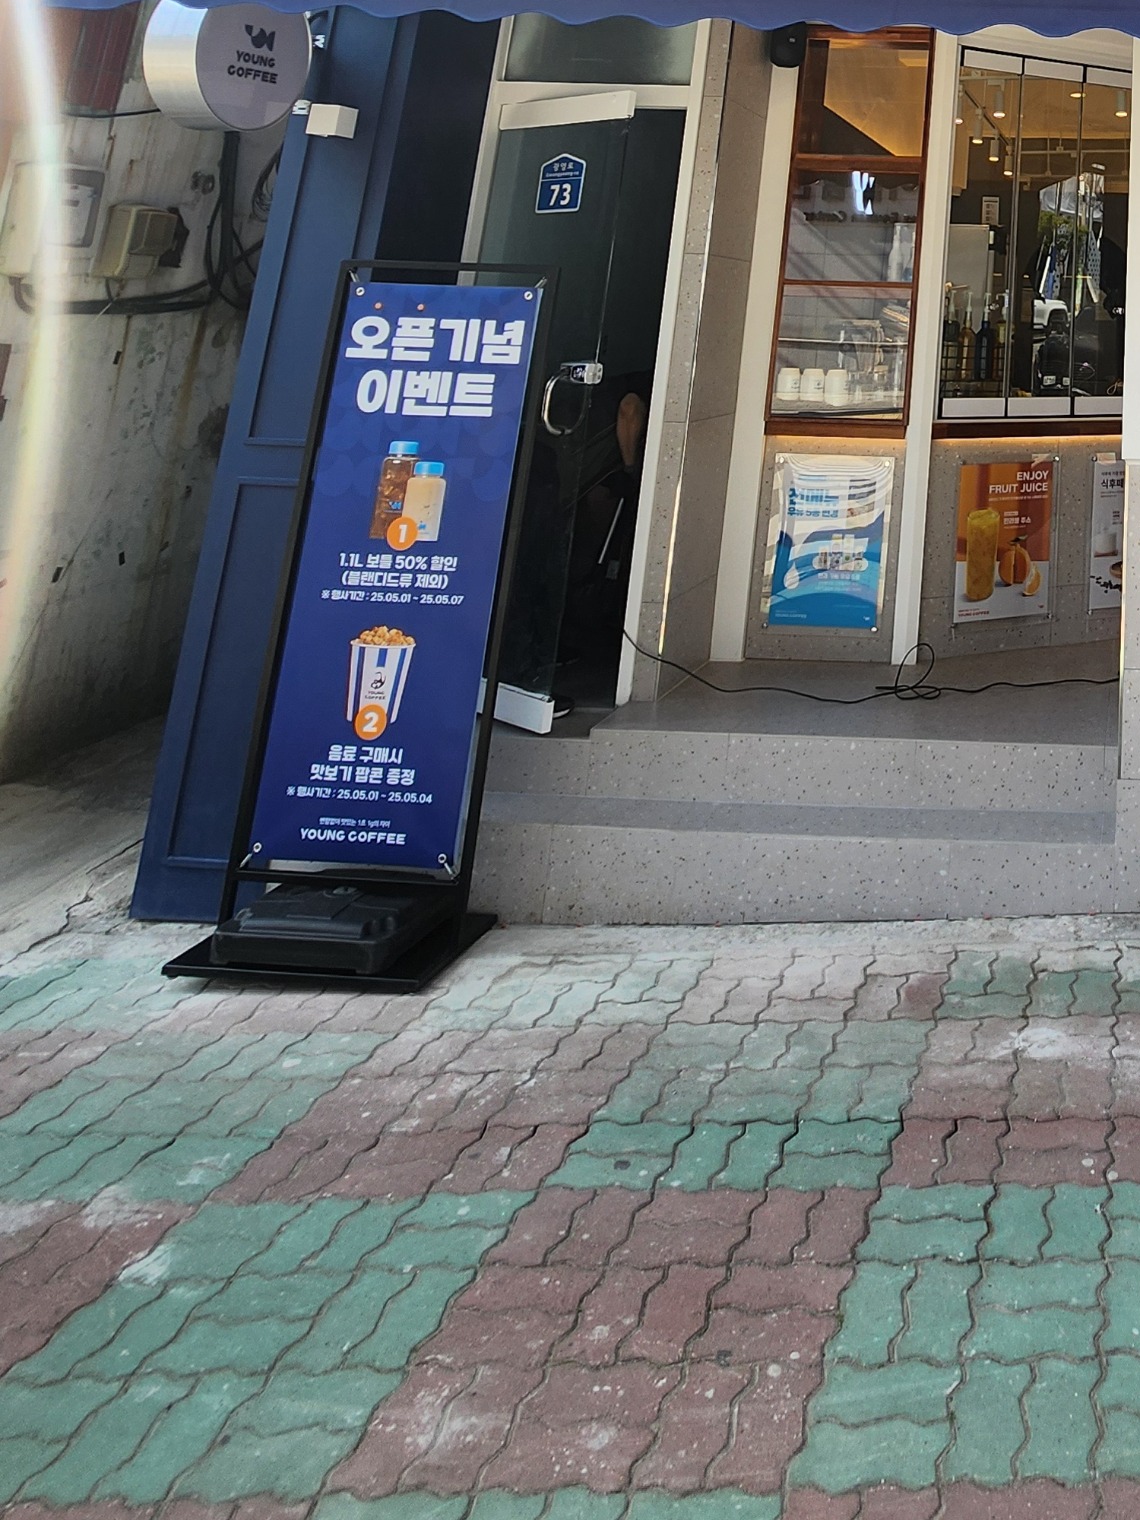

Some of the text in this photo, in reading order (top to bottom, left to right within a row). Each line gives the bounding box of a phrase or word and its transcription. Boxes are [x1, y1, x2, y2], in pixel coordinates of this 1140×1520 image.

[236, 50, 276, 68] YOUNG
[227, 64, 278, 85] COFFEE
[549, 183, 572, 207] 73
[344, 315, 526, 365] 오픈기념
[356, 369, 496, 417] 이벤트
[1016, 470, 1049, 481] ENJOY
[988, 482, 1049, 494] FRUIT JUICE
[398, 524, 408, 543] 1
[339, 553, 458, 572] 1.1L 보틀 50% 할인
[414, 573, 449, 590] 제외)
[370, 592, 411, 603] 25.05.01
[420, 594, 464, 605] 25.05.07
[362, 712, 379, 732] 2
[328, 744, 404, 765] 음료 구매시
[310, 764, 416, 786] 맛보기 팝콘 증정
[337, 788, 378, 801] 25.05.01
[388, 791, 433, 804] 25.05.04
[300, 828, 407, 845] YOUNG COFFEE
